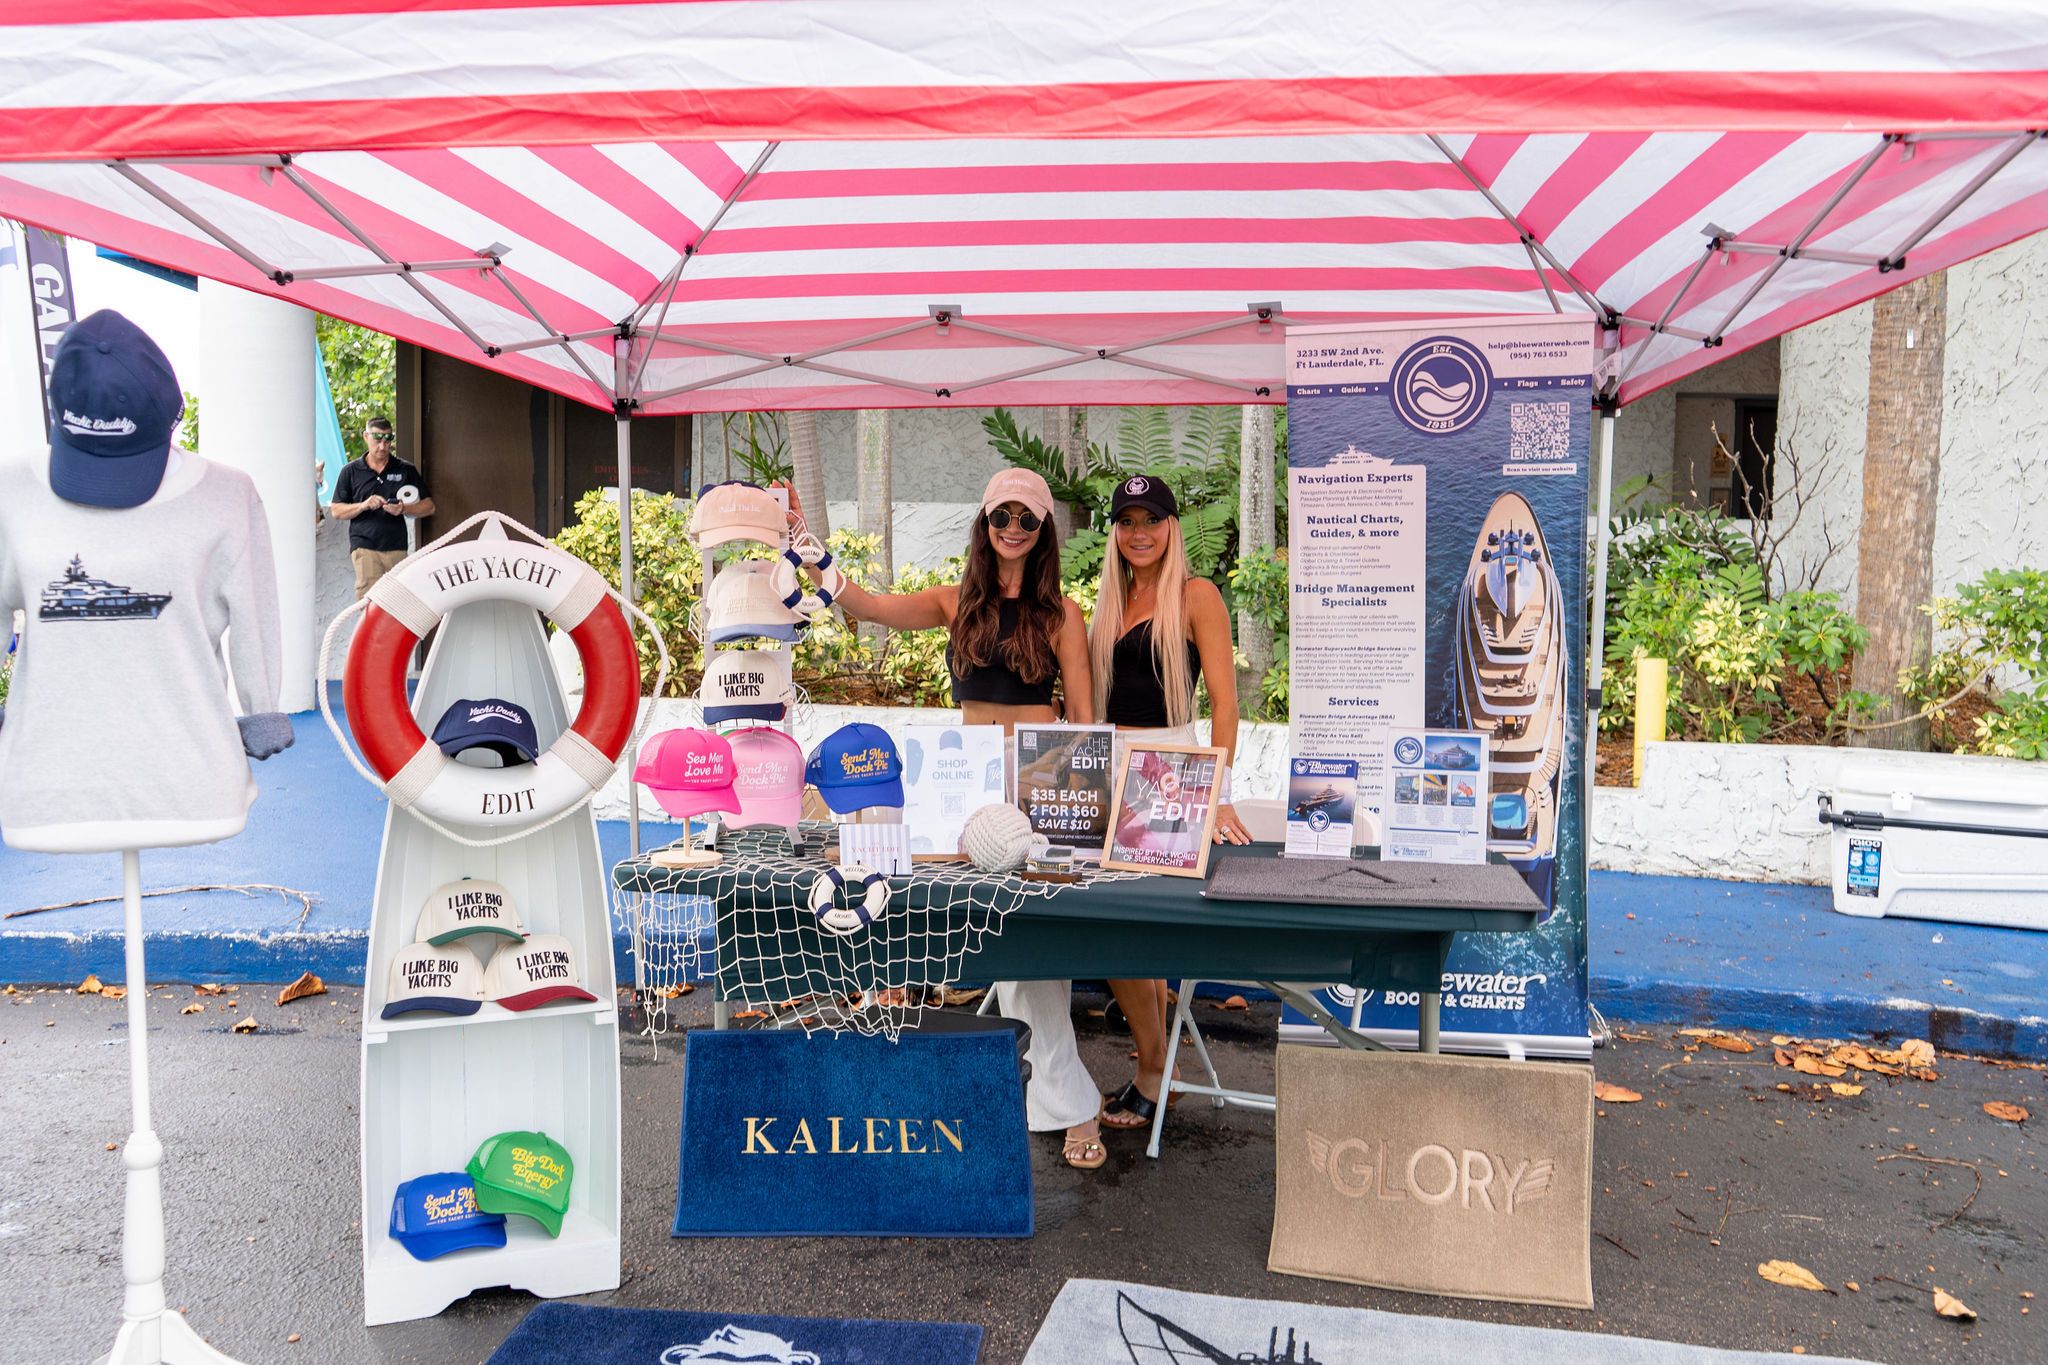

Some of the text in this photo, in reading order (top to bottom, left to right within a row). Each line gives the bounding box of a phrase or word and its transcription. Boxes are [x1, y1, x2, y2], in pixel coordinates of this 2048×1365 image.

[1432, 346, 1453, 354] Est.
[1488, 340, 1590, 349] help@bluewaterweb.com
[1309, 360, 1366, 368] Lauderdale,
[1426, 420, 1455, 429] 1985
[1298, 474, 1413, 485] Navigation Experts
[1307, 514, 1403, 524] Nautical Charts,
[1310, 529, 1399, 539] Guides, & more
[428, 556, 561, 591] THE YACHT
[1295, 584, 1415, 594] Bridge Management
[1322, 598, 1387, 608] Specialists
[719, 673, 764, 686] I LIKE BIG
[724, 685, 760, 697] YACHTS
[1329, 697, 1379, 706] Services
[470, 705, 522, 723] Yacht Daddy
[1085, 737, 1108, 748] THE
[686, 752, 723, 764] Sea Men
[841, 749, 867, 765] Send
[869, 748, 884, 760] Me
[1071, 747, 1108, 757] YACHT
[739, 763, 763, 774] Send
[844, 760, 888, 774] Dock Pic
[937, 759, 968, 768] SHOP
[1072, 757, 1108, 769] EDIT
[685, 764, 723, 777] Love Me
[932, 771, 974, 780] ONLINE
[1170, 762, 1216, 783] THE
[739, 773, 785, 785] Dock Pic
[1031, 787, 1098, 802] $35 EACH
[1137, 780, 1212, 803] YACHT
[482, 788, 535, 815] EDIT
[1030, 804, 1099, 818] 2 FOR $60
[1150, 800, 1209, 823] EDIT
[1038, 819, 1091, 831] SAVE $10
[1114, 846, 1144, 856] INSPIRED
[1170, 852, 1196, 860] WORLD
[1135, 855, 1184, 866] SUPERYACHTS
[448, 892, 503, 909] I LIKE BIG
[456, 905, 499, 921] YACHTS
[403, 959, 459, 976] I LIKE BIG
[517, 951, 569, 970] I LIKE BIG
[526, 964, 568, 982] YACHTS
[408, 974, 451, 989] YACHTS
[1441, 970, 1546, 995] ewater
[1444, 994, 1457, 1008] &
[1459, 994, 1525, 1010] CHARTS
[741, 1116, 964, 1154] KALEEN
[512, 1148, 564, 1181] Big Dock
[513, 1163, 558, 1189] Energy
[1327, 1137, 1531, 1215] GLORY
[424, 1189, 455, 1209] Send
[427, 1201, 463, 1220] Dock
